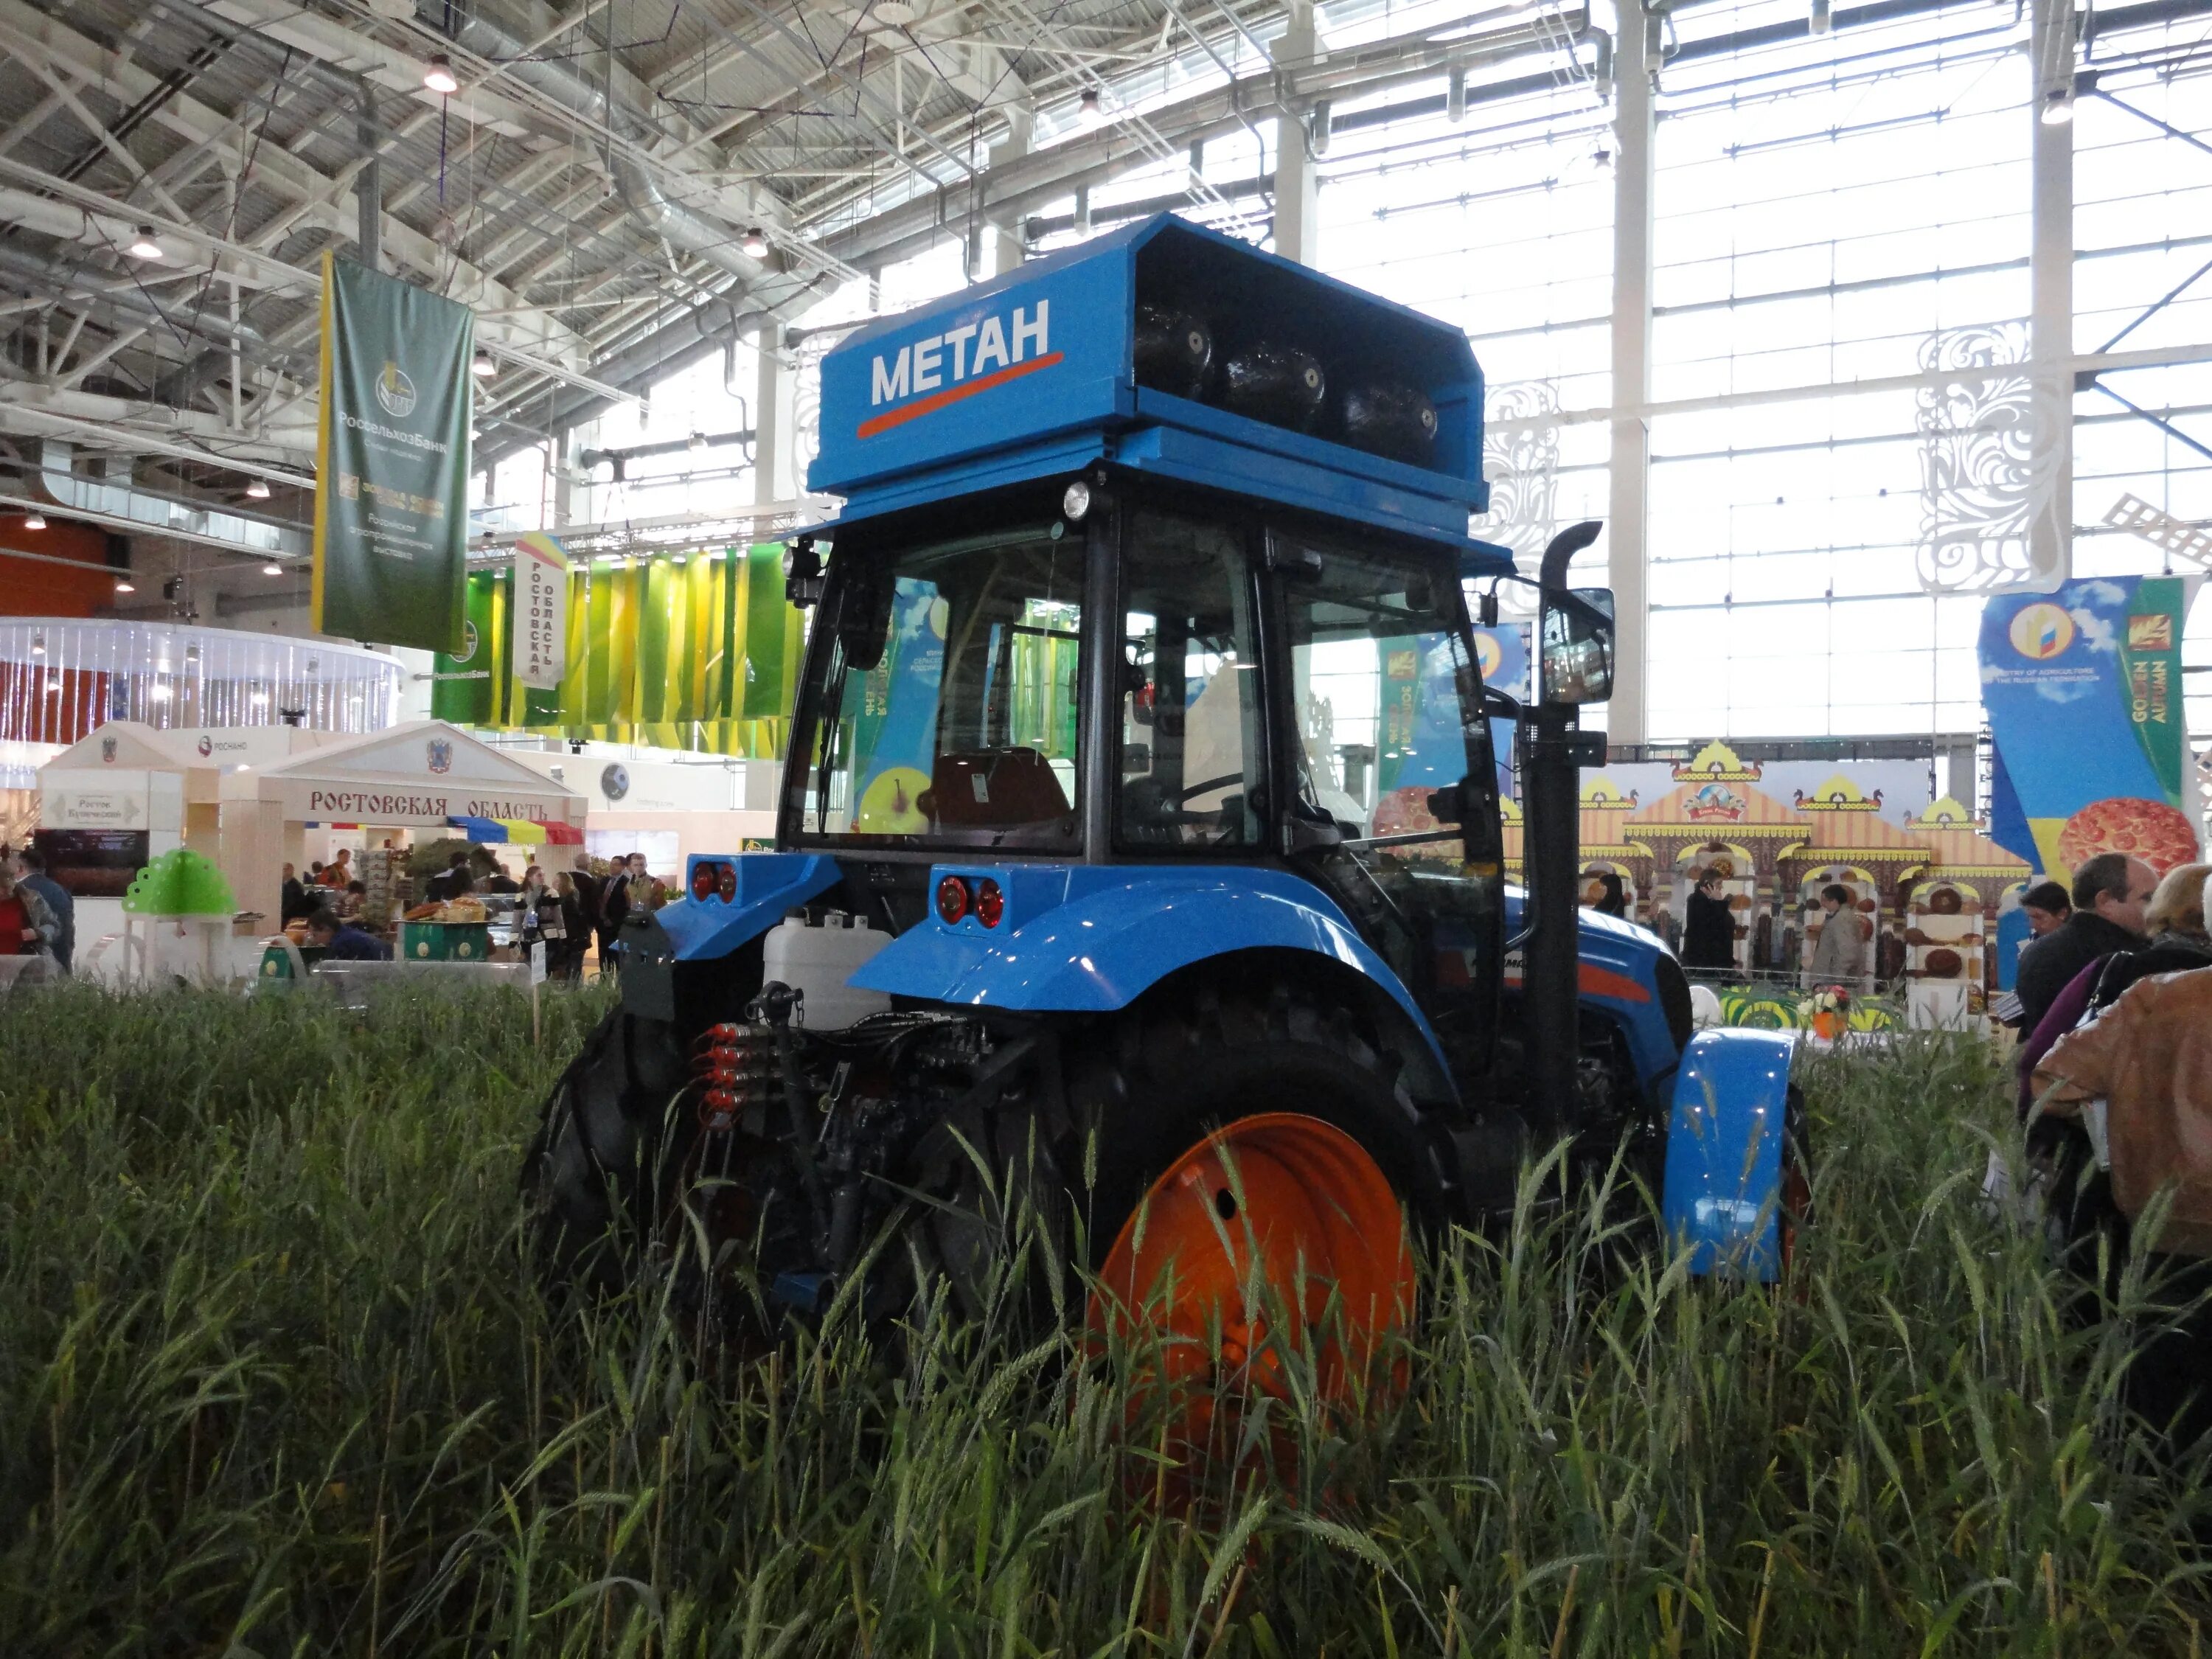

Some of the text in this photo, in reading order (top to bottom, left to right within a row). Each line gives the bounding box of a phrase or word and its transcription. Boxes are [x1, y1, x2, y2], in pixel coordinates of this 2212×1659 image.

[872, 299, 1048, 406] МЕТАН
[529, 562, 541, 675] РОСТОВСКАЯ
[543, 585, 554, 665] ОБЛАСТЬ
[310, 791, 548, 821] РОСТОВСКАЯ ОБЛАСТЬ
